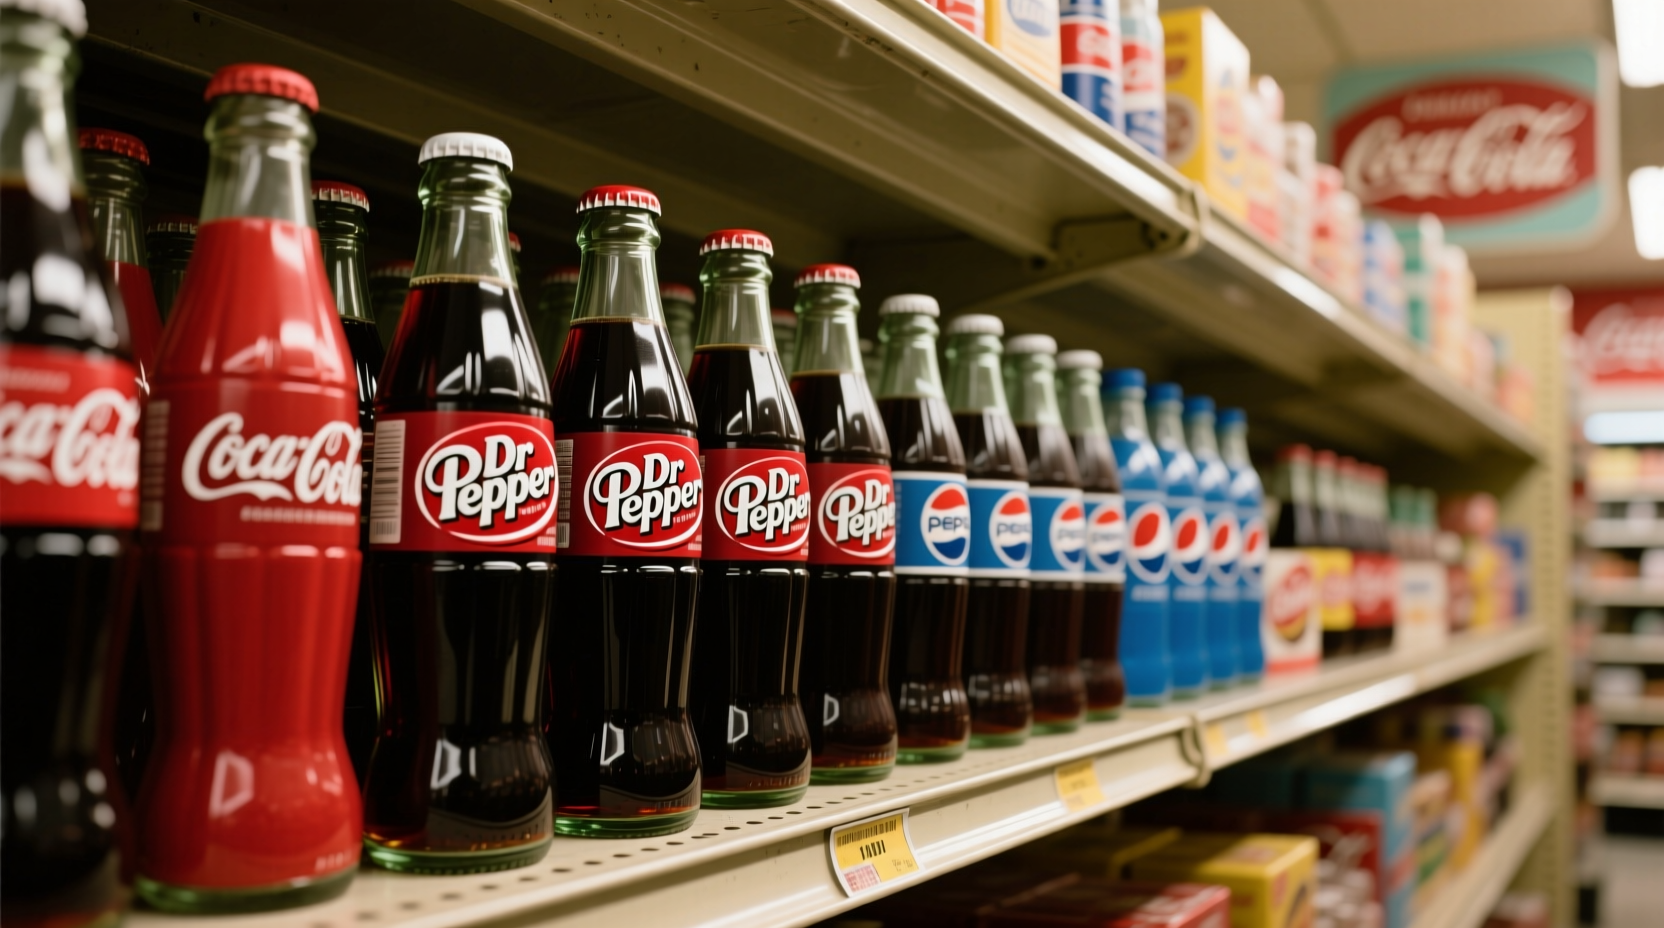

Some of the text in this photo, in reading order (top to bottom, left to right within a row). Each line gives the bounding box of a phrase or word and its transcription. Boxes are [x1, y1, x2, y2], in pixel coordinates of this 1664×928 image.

[181, 411, 363, 507] Coca-Cola
[424, 444, 555, 527] Pepper
[483, 434, 534, 479] Dr
[643, 453, 684, 490] Dr
[768, 467, 800, 501] Dr
[592, 462, 702, 534] Pepper
[723, 475, 810, 540] Pepper
[825, 486, 896, 546] Peppe
[865, 479, 890, 511] Dr
